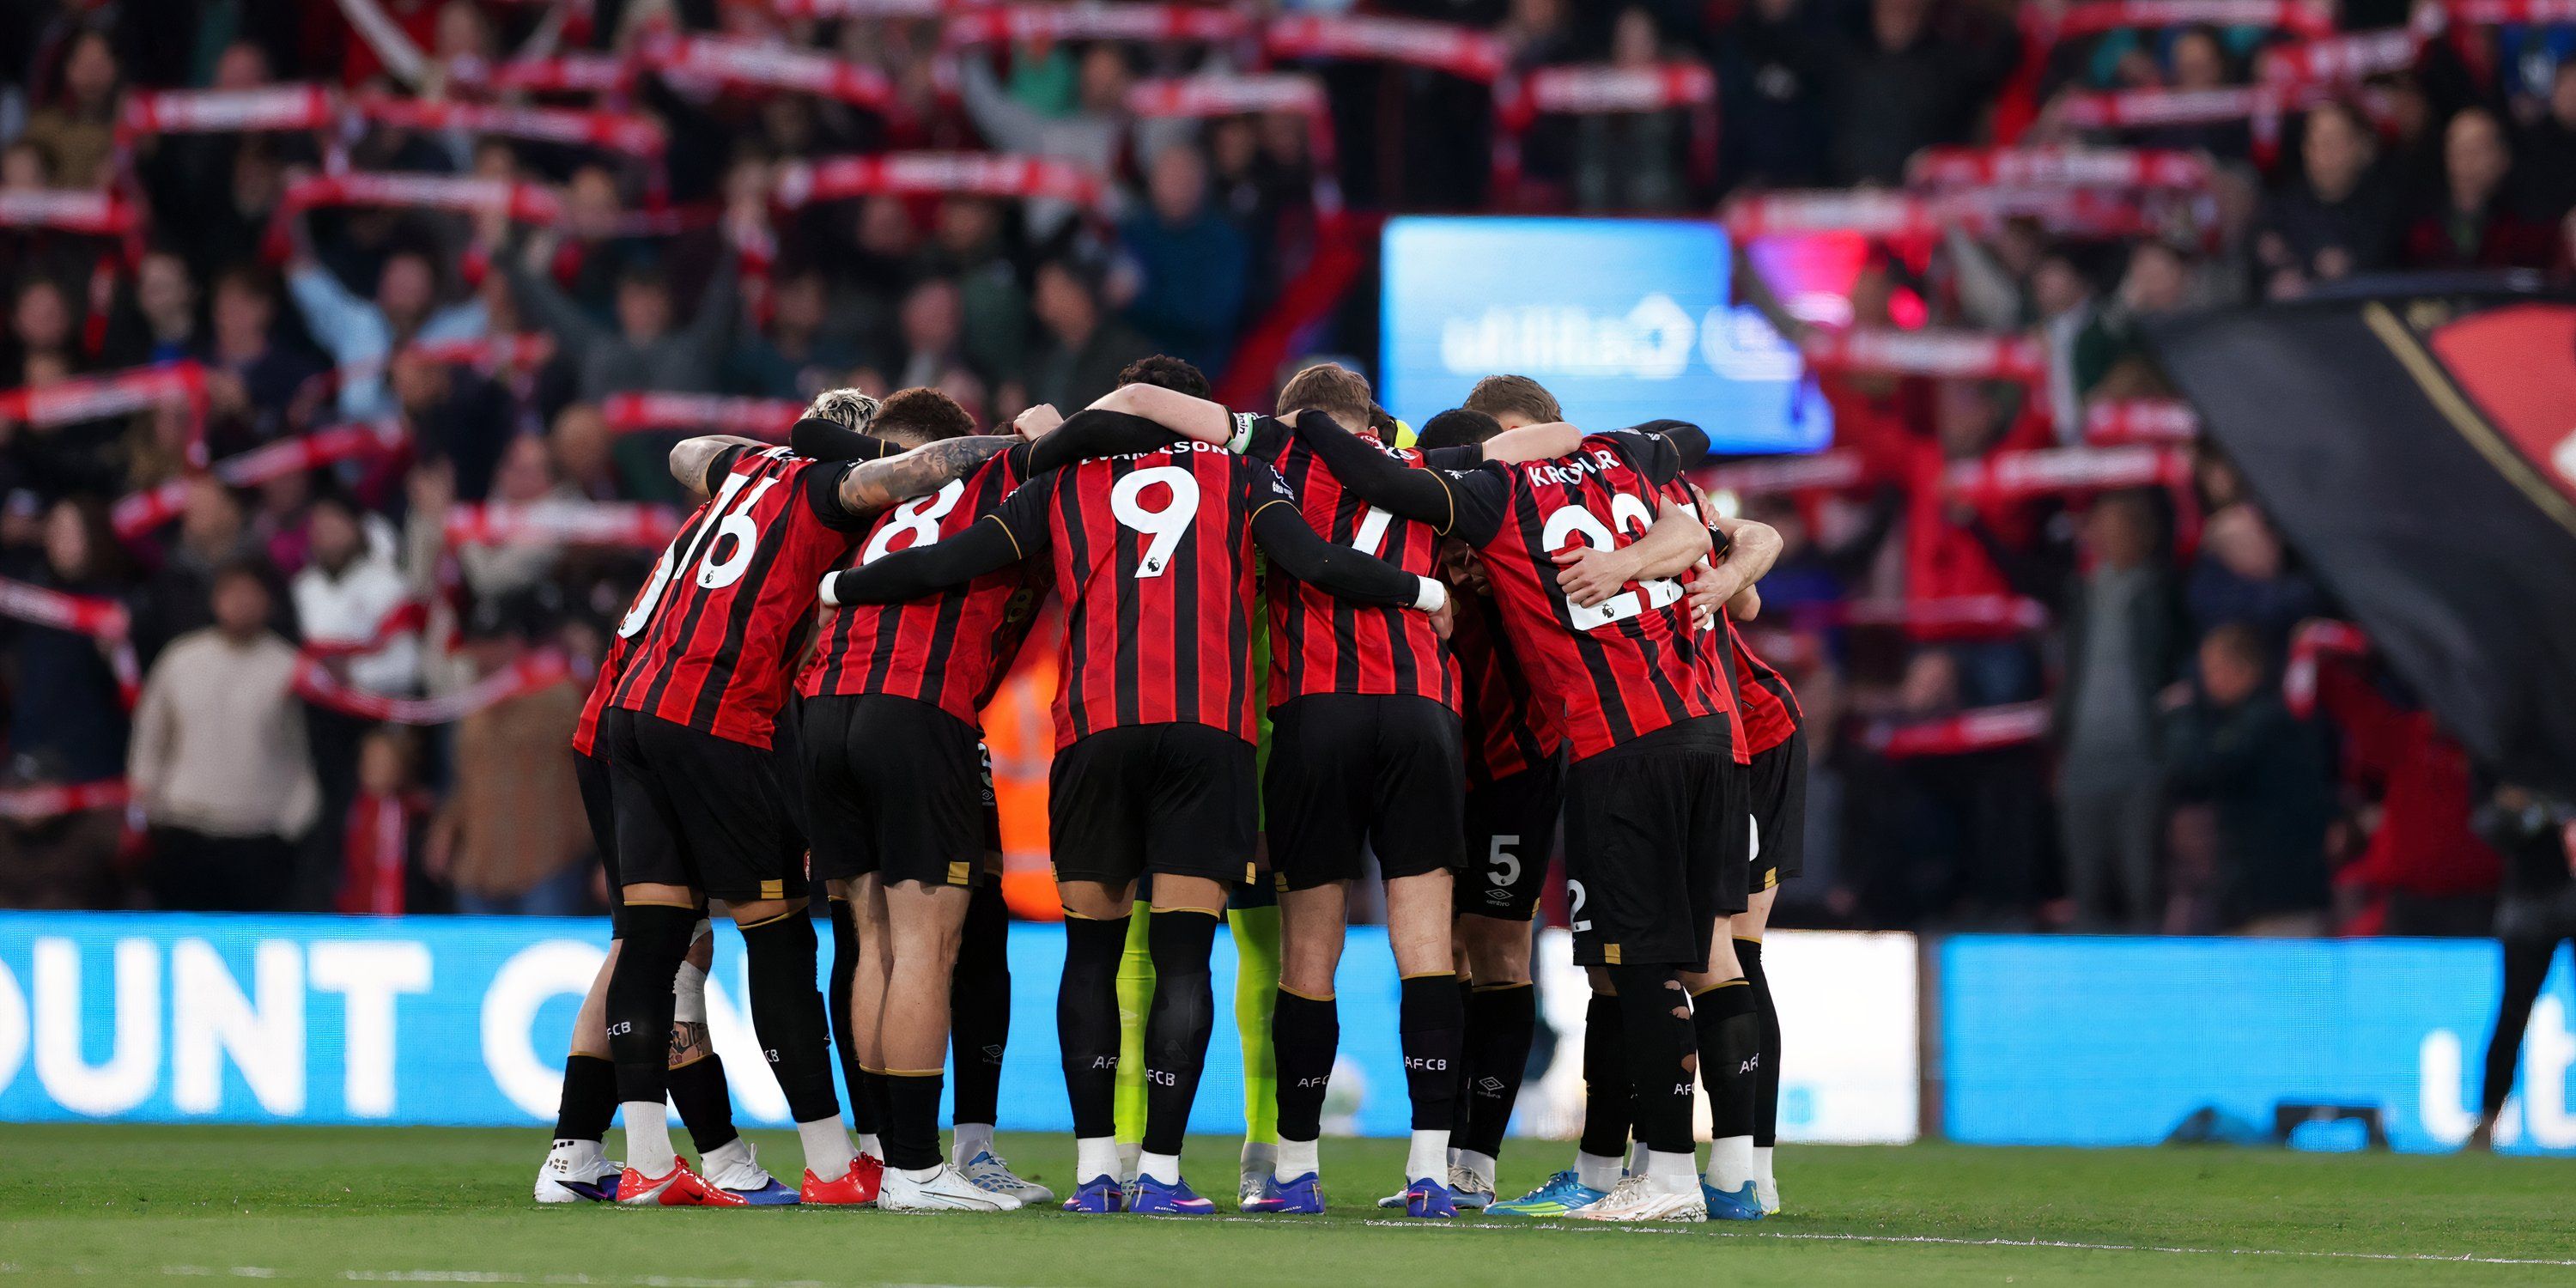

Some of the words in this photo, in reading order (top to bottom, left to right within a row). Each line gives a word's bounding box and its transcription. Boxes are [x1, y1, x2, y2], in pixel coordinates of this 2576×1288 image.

[1081, 440, 1230, 465] ALSON
[672, 471, 780, 590] 16
[862, 477, 966, 566] 8
[1110, 465, 1201, 579] 9
[1486, 835, 1522, 887] 5
[1566, 878, 1593, 933] 2
[0, 937, 434, 1118] UNT
[1405, 1055, 1447, 1071] AFCB
